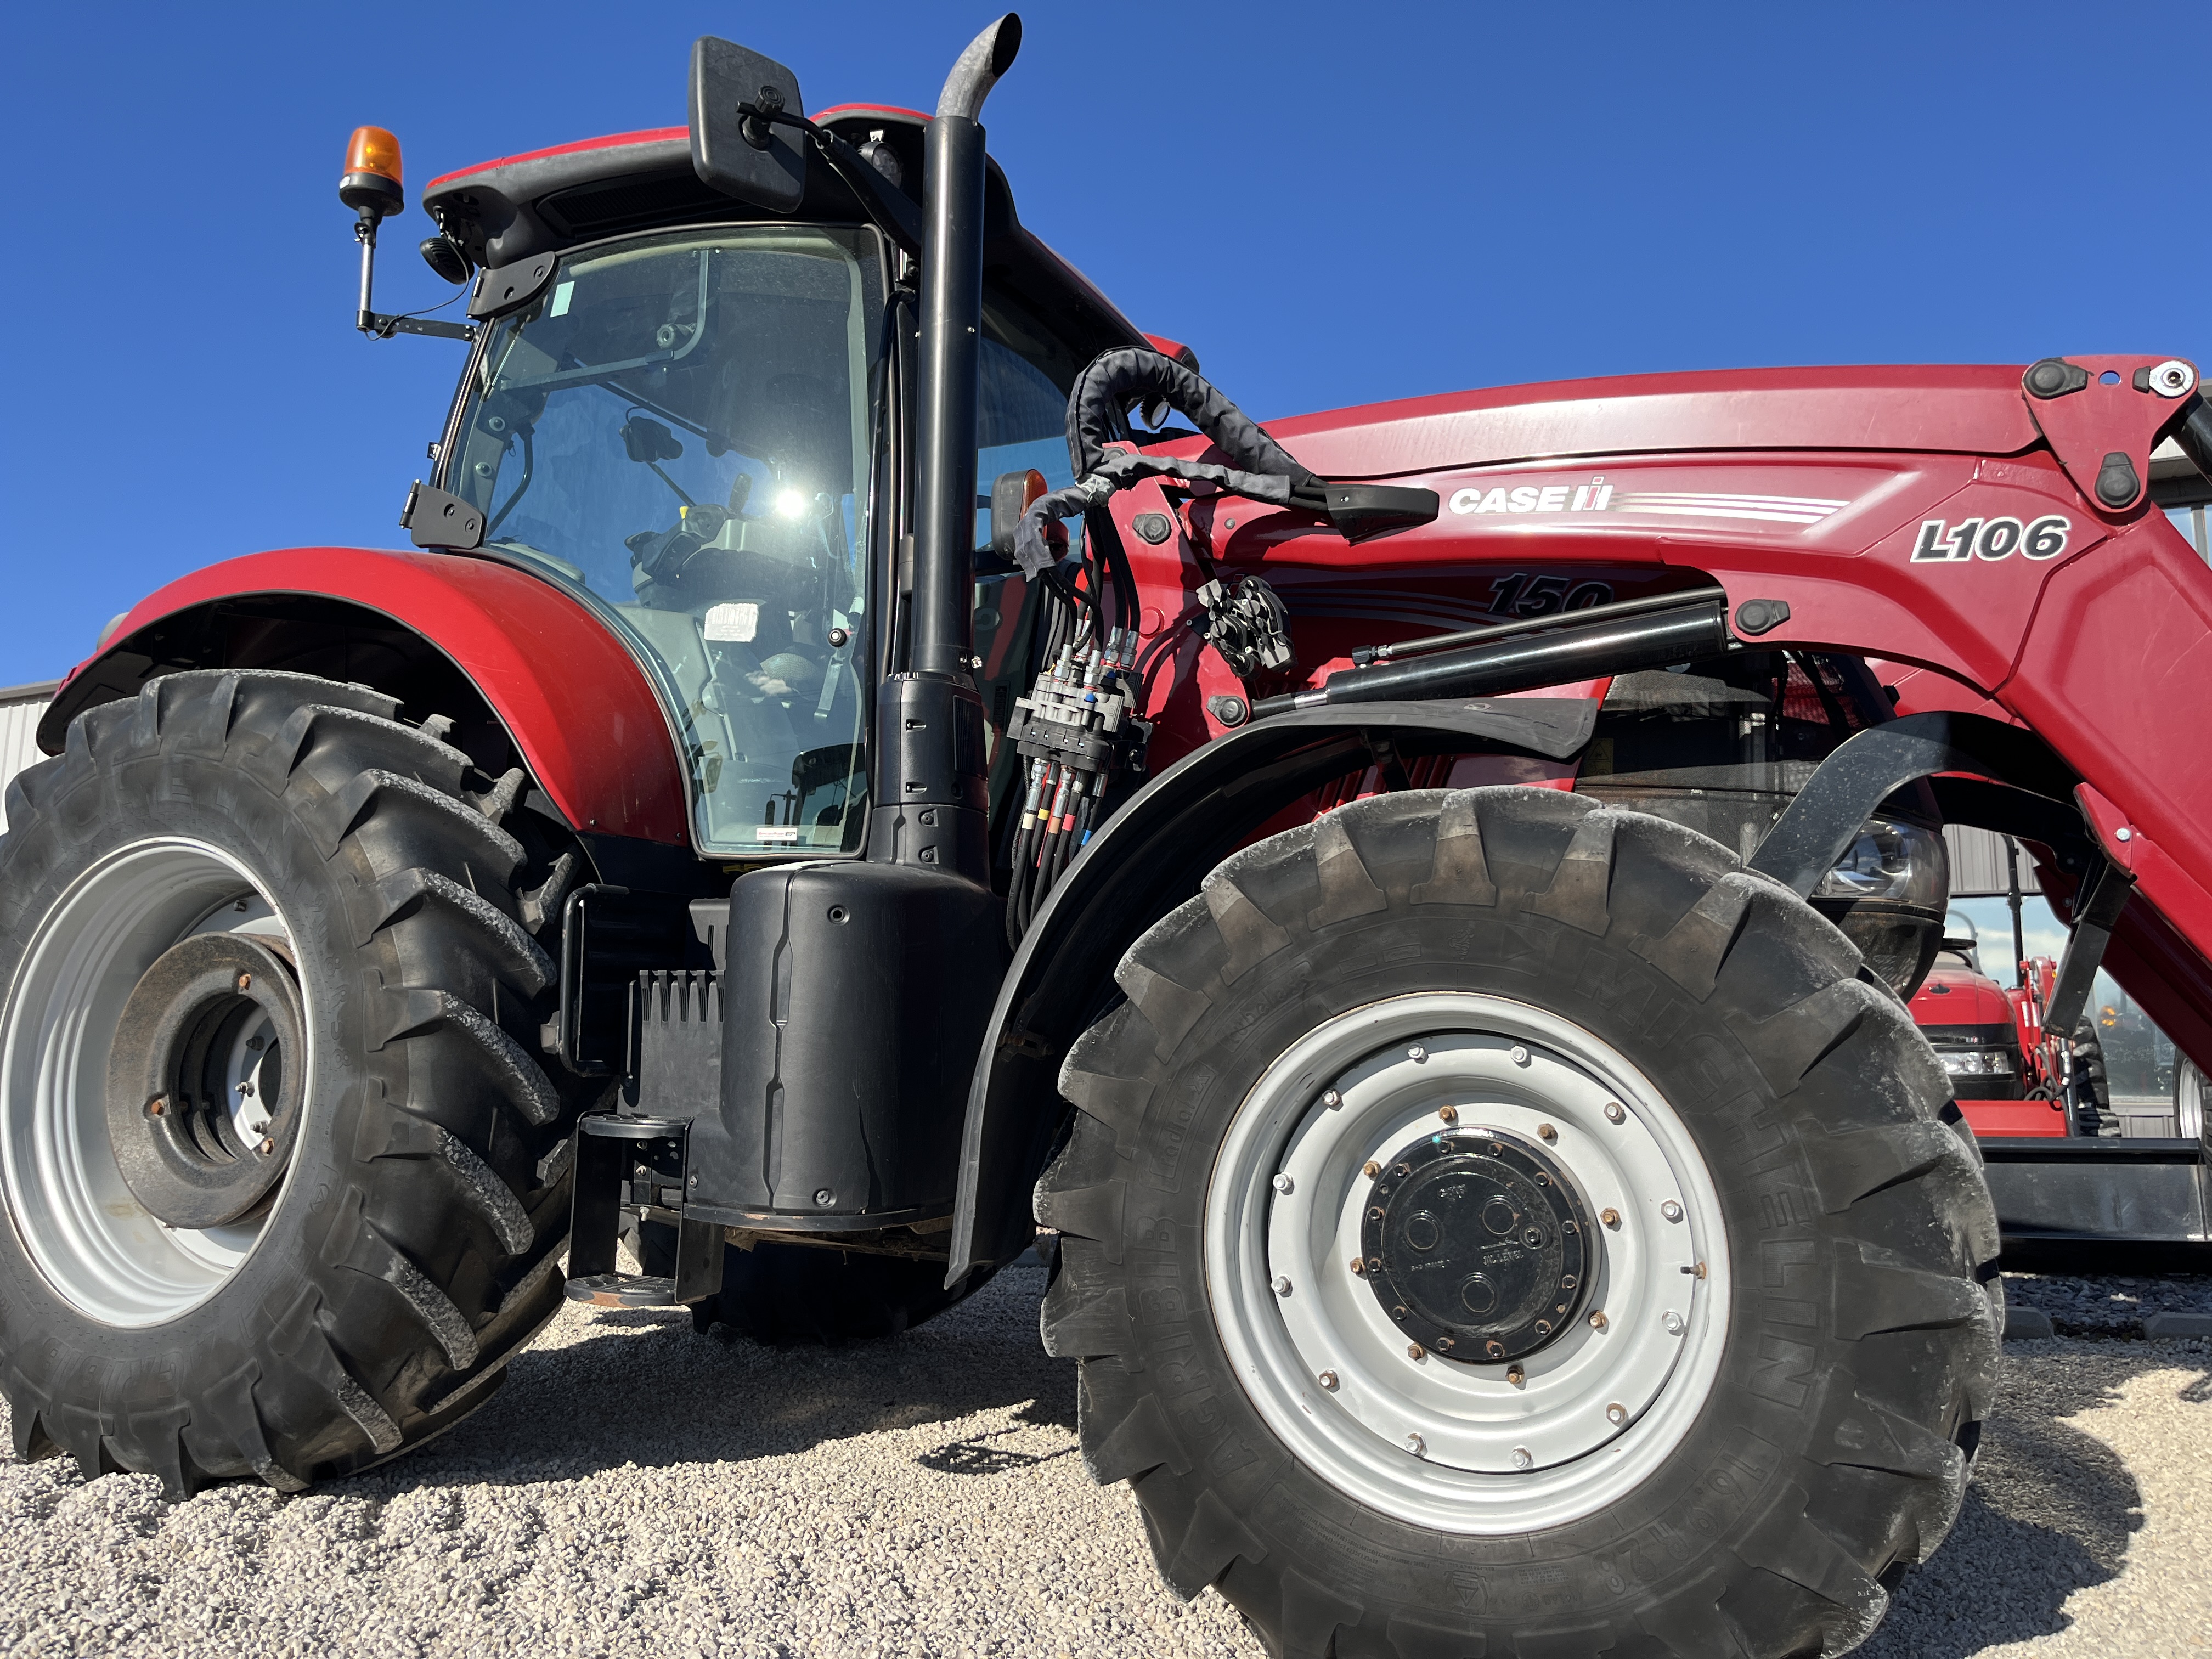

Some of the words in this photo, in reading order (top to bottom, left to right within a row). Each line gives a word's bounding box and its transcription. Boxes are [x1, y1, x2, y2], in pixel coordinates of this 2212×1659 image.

[1448, 485, 1570, 515] CASE
[1910, 515, 2072, 564] L106
[1487, 572, 1614, 618] 150
[1222, 970, 1310, 1046] tubeless
[1159, 1099, 1197, 1169] radial
[1571, 945, 1823, 1415] MICHELIN
[1132, 1214, 1260, 1491] AGRIBIB
